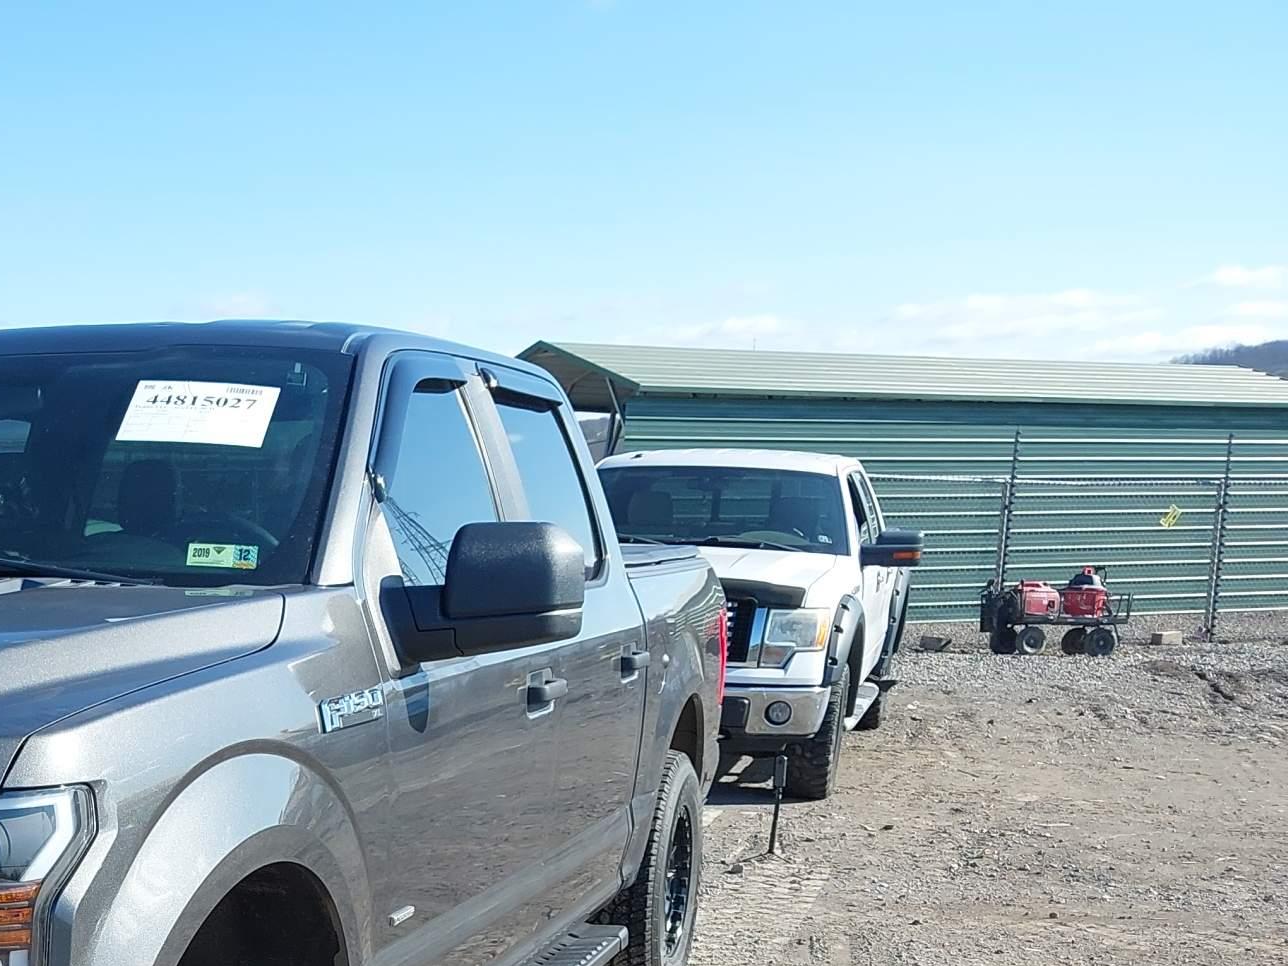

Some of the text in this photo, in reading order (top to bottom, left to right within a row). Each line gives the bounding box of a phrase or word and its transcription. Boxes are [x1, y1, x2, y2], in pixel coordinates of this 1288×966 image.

[145, 394, 258, 410] 44815027
[192, 547, 211, 558] 2019
[238, 548, 251, 561] 12
